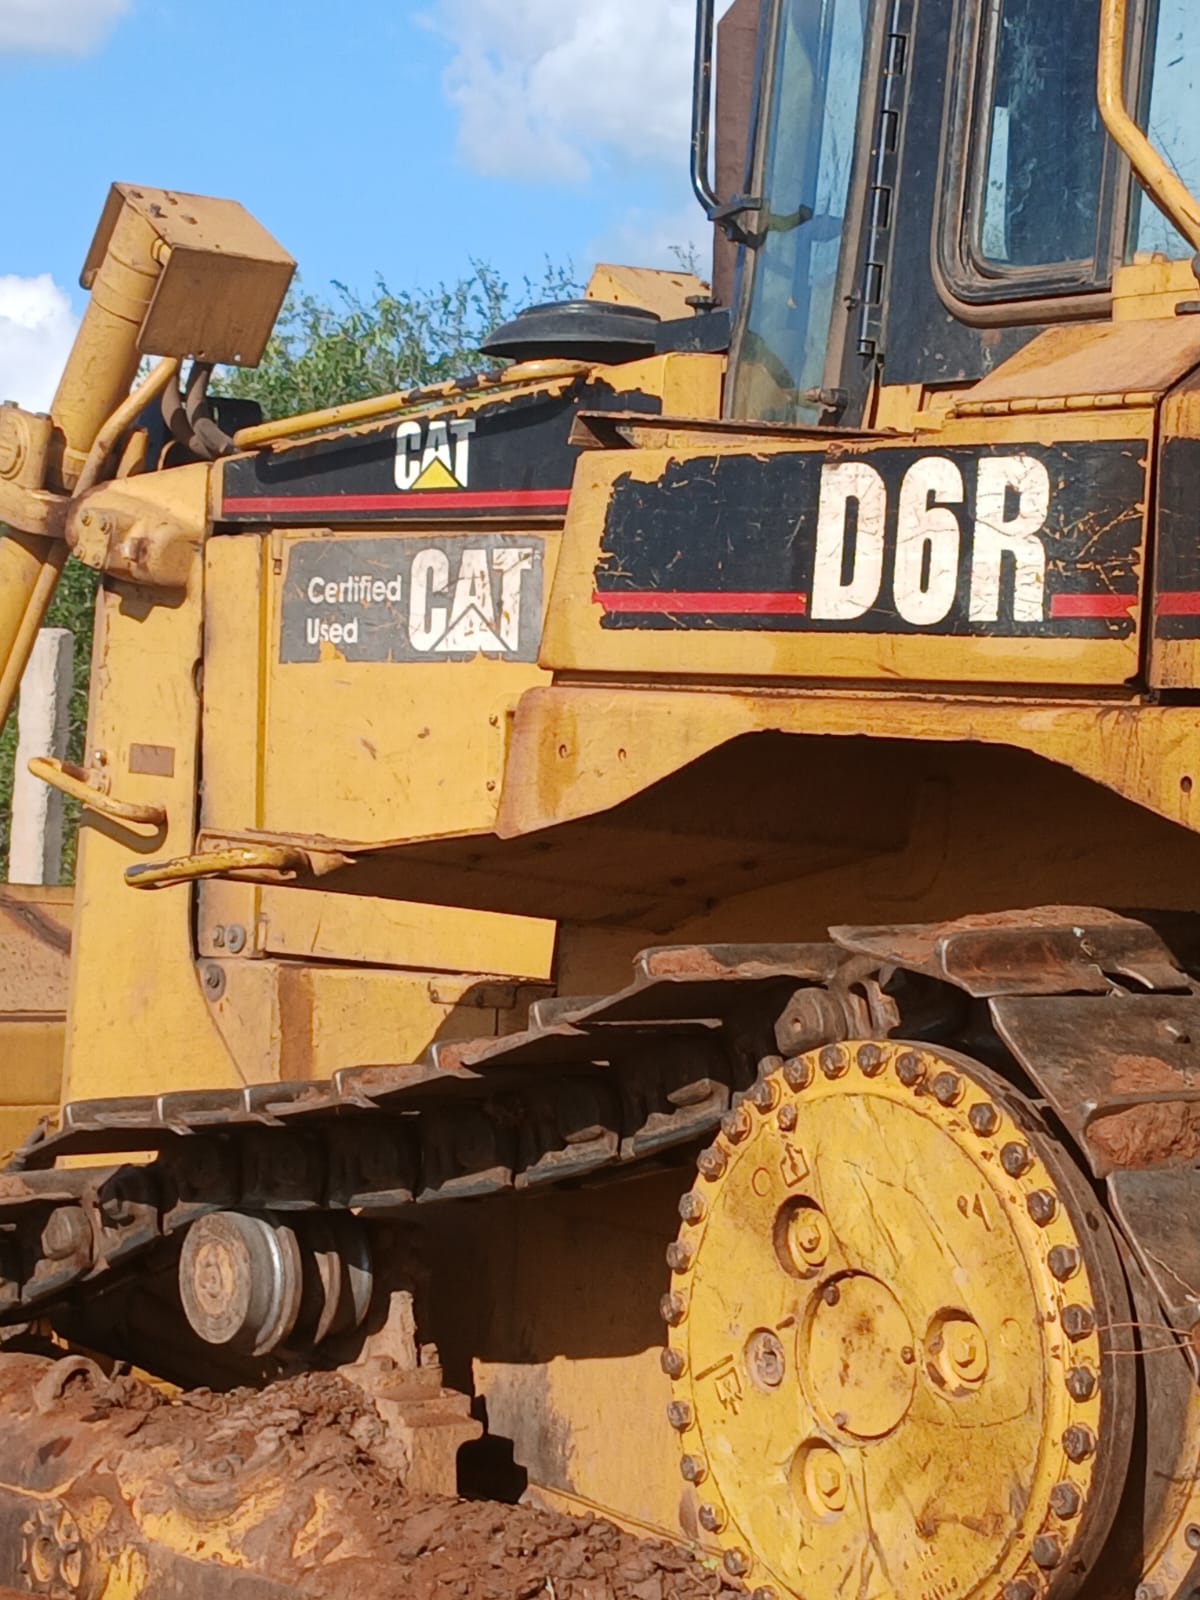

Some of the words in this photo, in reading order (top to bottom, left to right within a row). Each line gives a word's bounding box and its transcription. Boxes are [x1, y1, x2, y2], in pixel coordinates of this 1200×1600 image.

[395, 419, 476, 490] CAT
[811, 456, 1050, 625] D6R
[307, 575, 402, 604] Certified
[409, 548, 533, 651] CAT
[306, 617, 358, 644] Used
